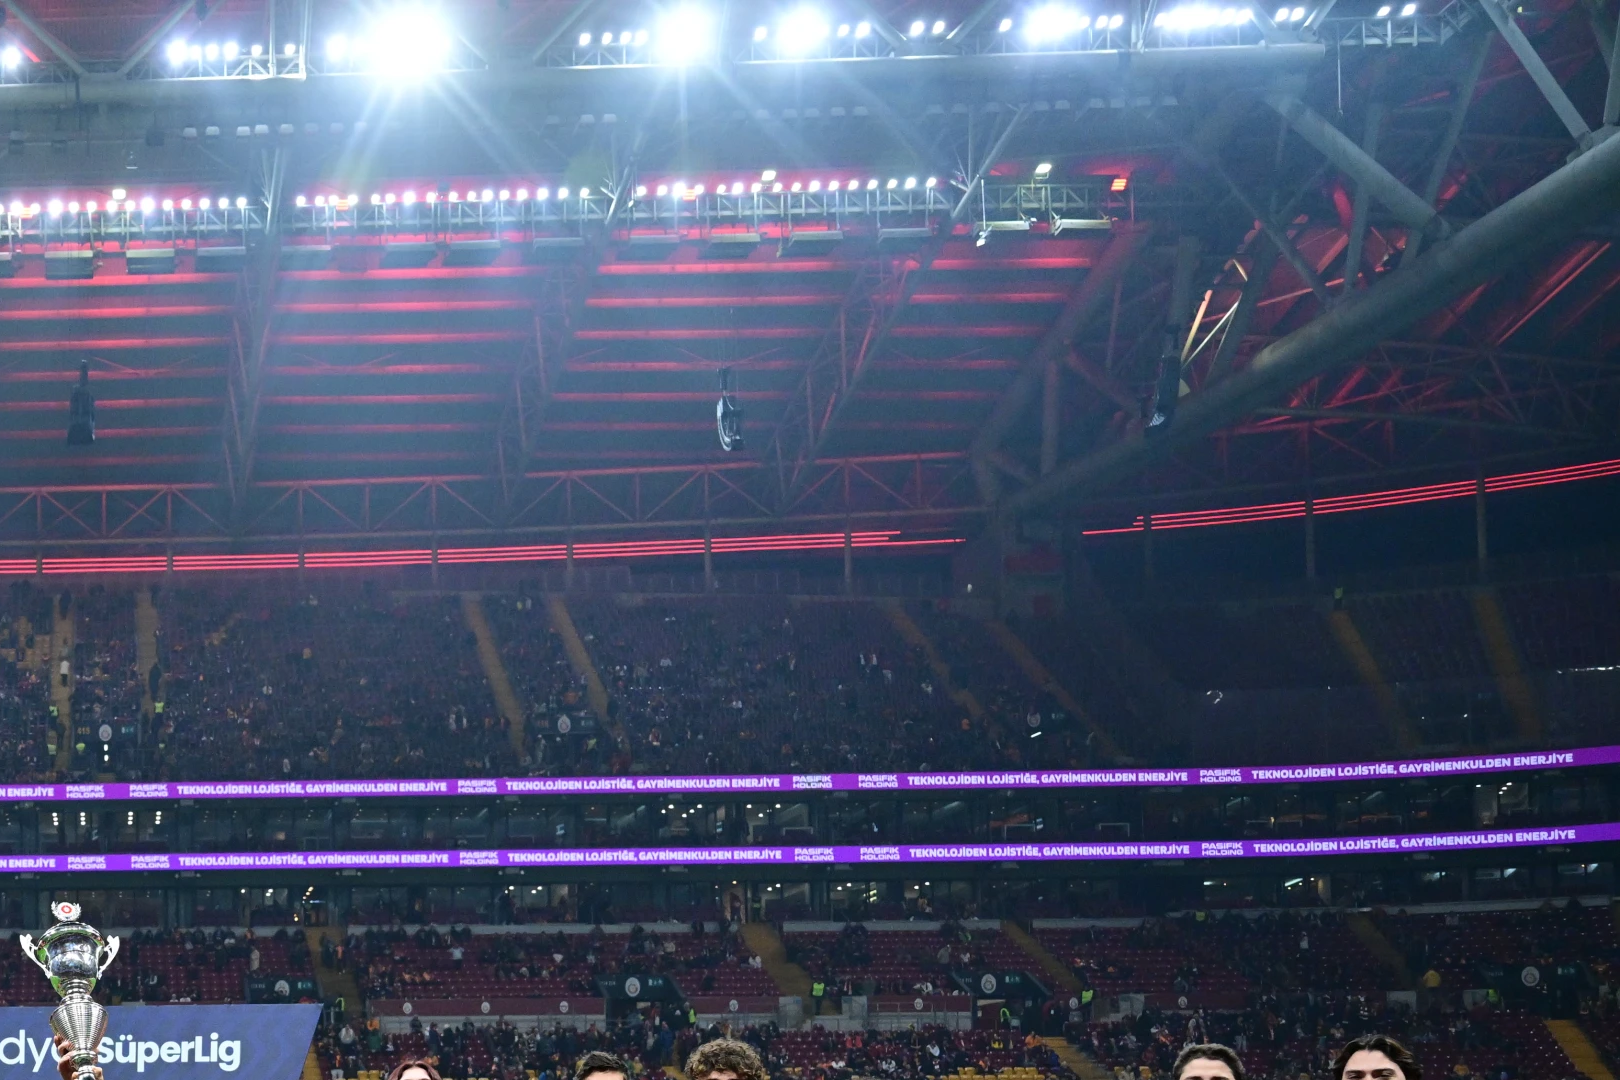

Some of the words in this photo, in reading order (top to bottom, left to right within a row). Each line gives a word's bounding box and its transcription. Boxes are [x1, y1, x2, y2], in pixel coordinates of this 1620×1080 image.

[1252, 768, 1335, 779] TEKNOLOJİDEN
[1399, 758, 1510, 773] GAYRİMENKULDEN
[1514, 754, 1573, 766] ENERJİYE
[506, 780, 582, 790] TEKNOLOJİDEN
[637, 779, 730, 788] GAYRİMENKULDEN
[732, 777, 780, 787] ENERJİYE
[908, 775, 985, 785] TEKNOLOJİDEN
[1041, 773, 1136, 783] GAYRİMENKULDEN
[1138, 771, 1187, 781] ENERJİYE
[7, 787, 54, 797] ENERJİYE
[177, 785, 252, 794] TEKNOLOJİDEN
[306, 783, 398, 793] GAYRİMENKULDEN
[399, 781, 447, 792] ENERJİYE
[1253, 842, 1337, 852] TEKNOLOJİDEN
[1401, 834, 1513, 847] GAYRİMENKULDEN
[1516, 830, 1575, 841] ENERJİYE
[508, 852, 584, 862] TEKNOLOJİDEN
[639, 851, 732, 860] GAYRİMENKULDEN
[733, 849, 782, 859] ENERJİYE
[909, 848, 987, 857] TEKNOLOJİDEN
[1043, 846, 1138, 856] GAYRİMENKULDEN
[1140, 845, 1189, 854] ENERJİYE
[8, 858, 56, 868] ENERJİYE
[179, 856, 254, 866] TEKNOLOJİDEN
[307, 854, 400, 864] GAYRİMENKULDEN
[401, 853, 449, 863] ENERJİYE
[98, 1032, 241, 1073] SüperLig
